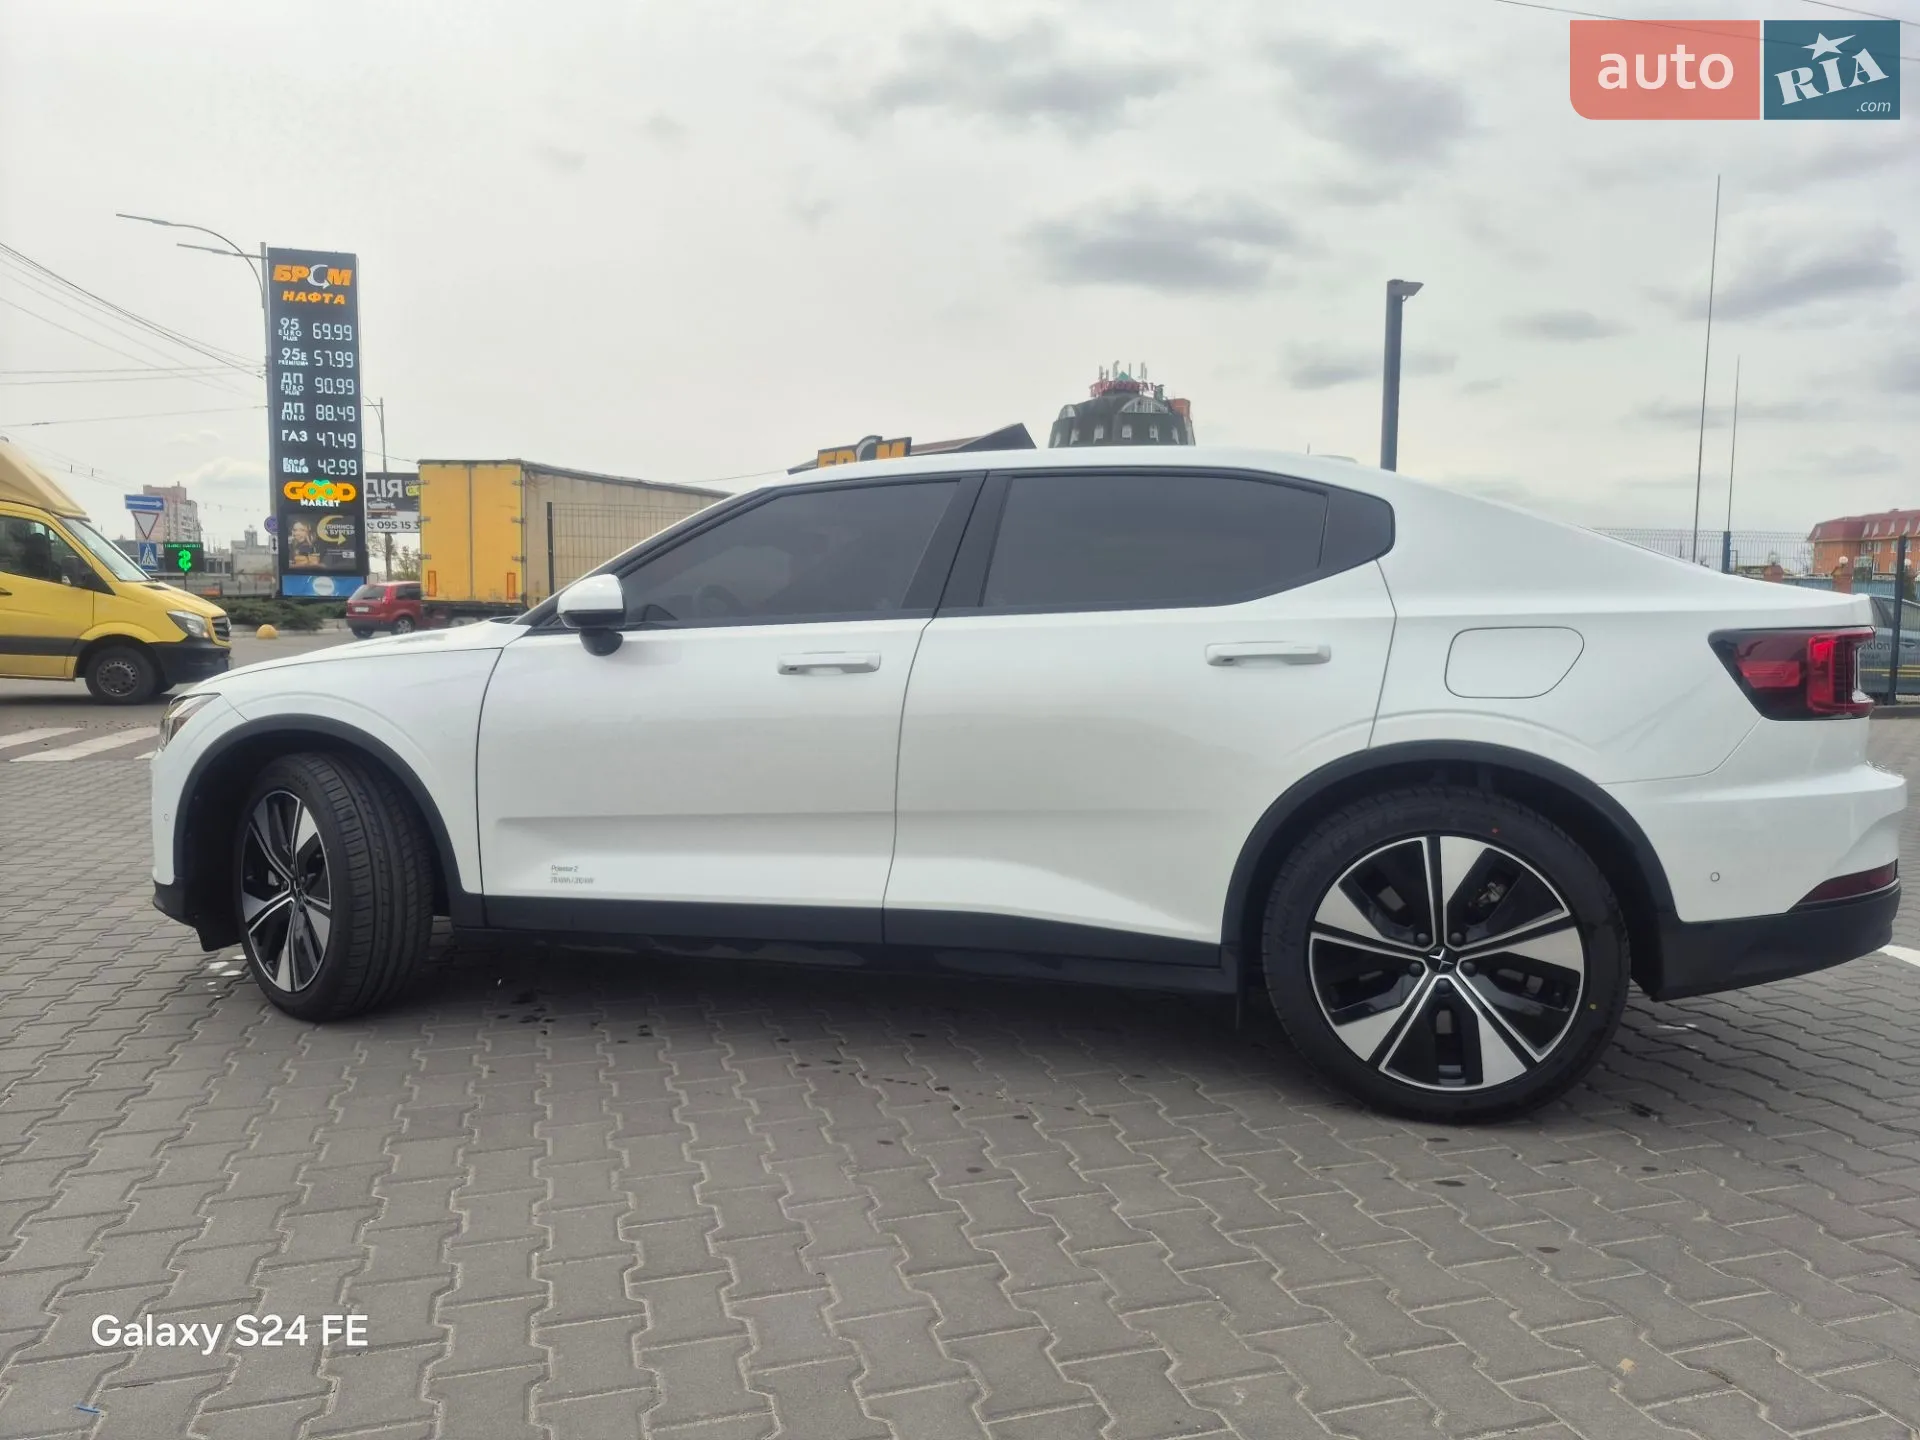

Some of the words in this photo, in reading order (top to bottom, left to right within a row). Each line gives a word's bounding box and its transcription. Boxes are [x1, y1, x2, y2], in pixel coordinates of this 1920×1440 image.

[282, 290, 346, 305] НАФТА
[280, 317, 300, 331] 95
[312, 322, 353, 341] 69.99
[278, 329, 302, 337] EURO
[313, 349, 354, 368] 57.99
[281, 372, 303, 386] ДП
[314, 377, 355, 395] 90.99
[282, 402, 304, 415] ДП
[315, 404, 356, 422] 88.49
[281, 429, 308, 442] ГАЗ
[316, 431, 357, 449] 47.49
[317, 458, 358, 476] 42.99
[283, 481, 356, 502] GOOD
[300, 499, 340, 507] MARKET
[376, 521, 398, 530] 095
[400, 521, 412, 530] 15
